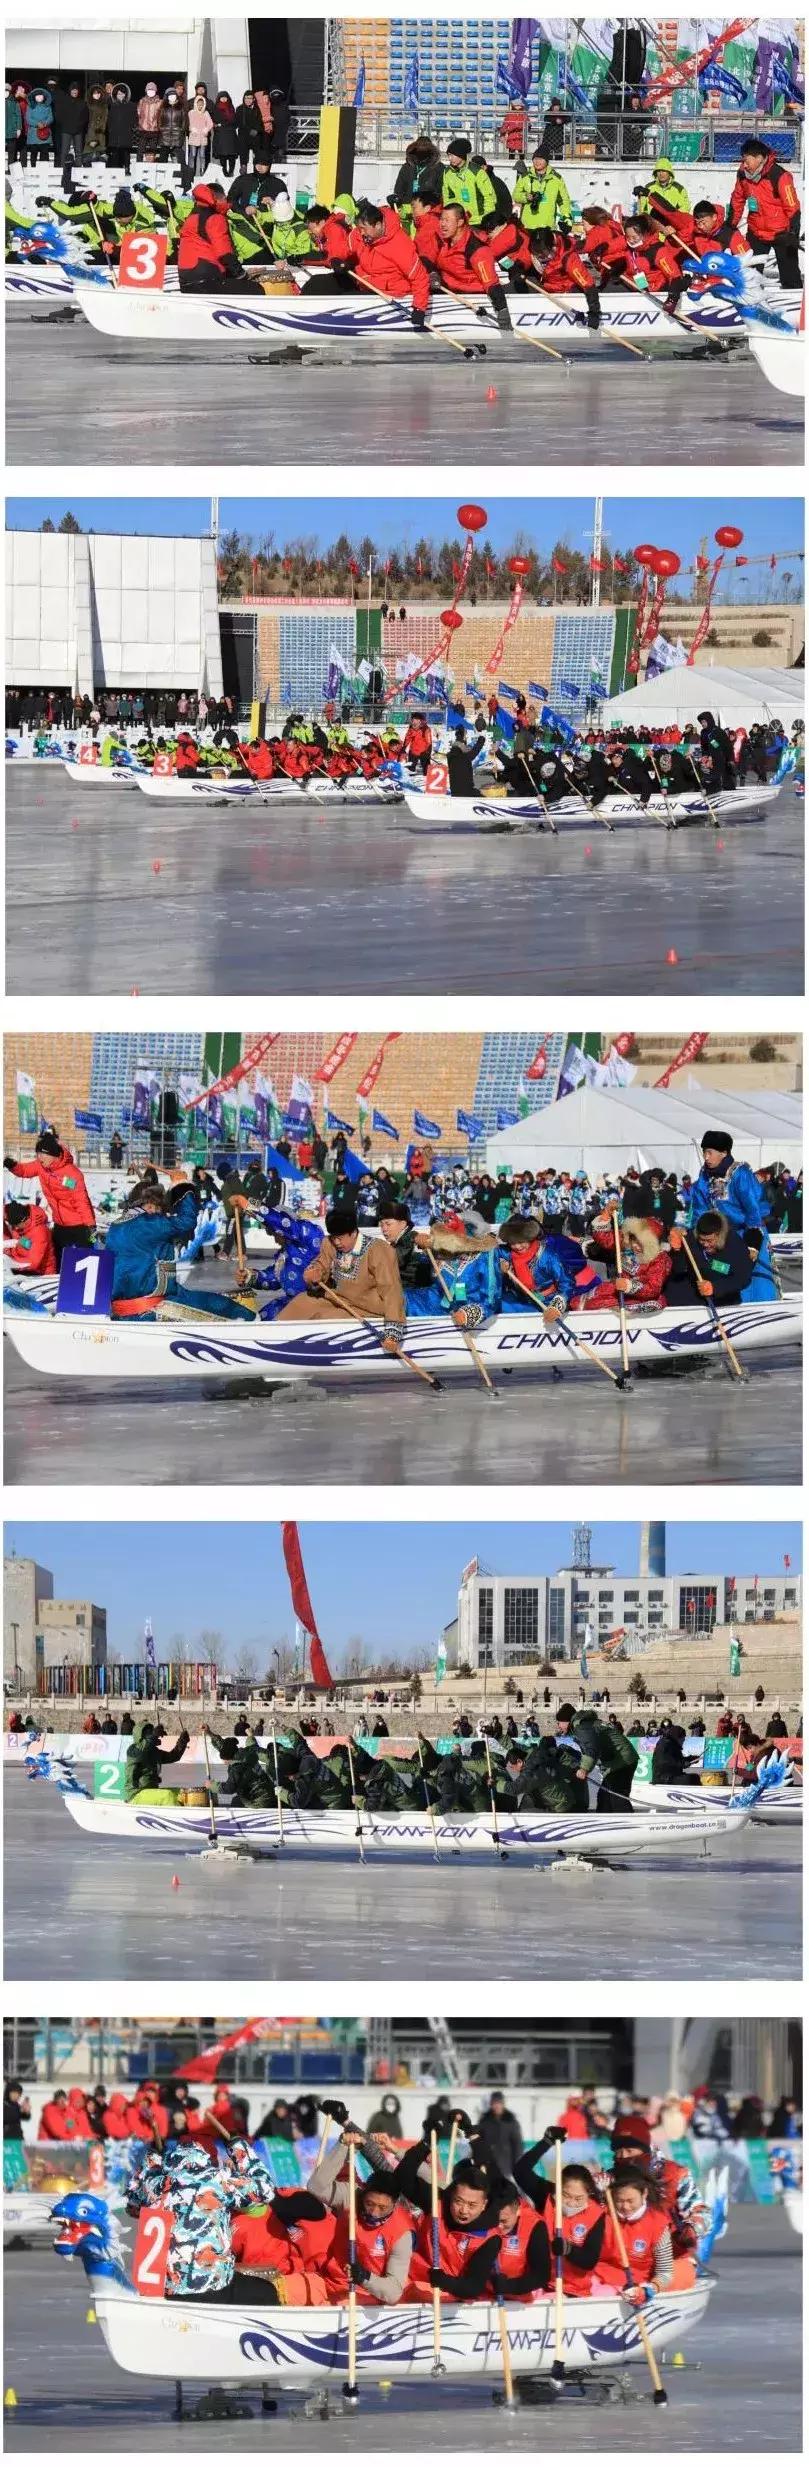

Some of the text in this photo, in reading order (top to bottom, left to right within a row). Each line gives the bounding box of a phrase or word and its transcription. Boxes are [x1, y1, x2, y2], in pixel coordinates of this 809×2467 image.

[127, 237, 158, 280] 3
[516, 312, 660, 326] CHAPION
[83, 750, 92, 763] 4
[156, 754, 170, 773] 3
[429, 768, 445, 790] 2
[612, 803, 678, 812] CHAPION
[75, 1256, 100, 1305] 1
[635, 1755, 648, 1777] 3
[100, 1764, 120, 1794] 2
[91, 2150, 102, 2182] 3
[138, 2216, 166, 2284] 2
